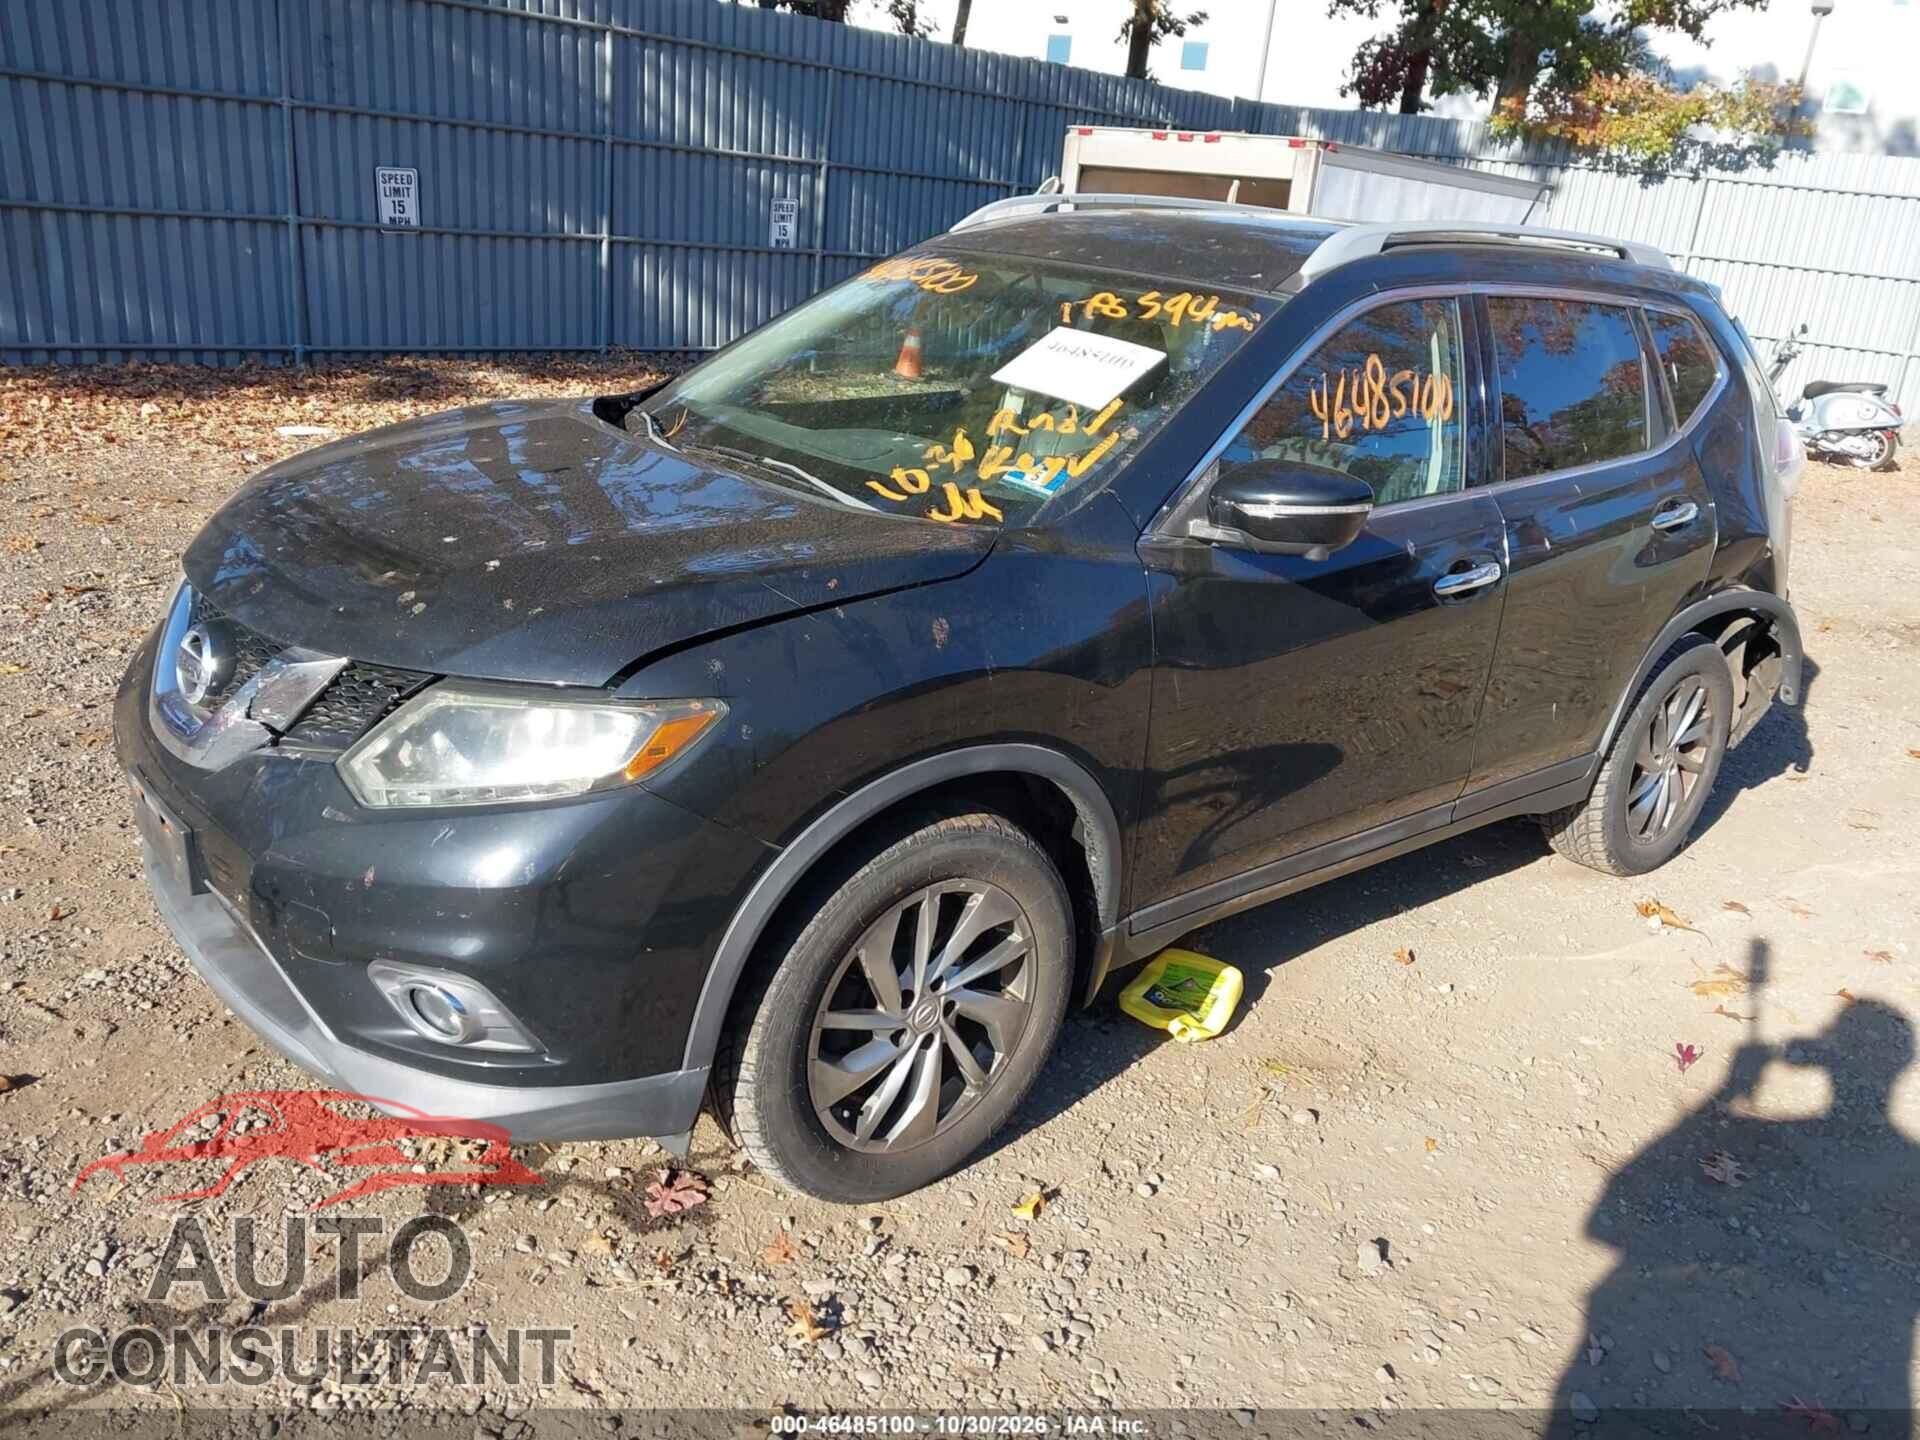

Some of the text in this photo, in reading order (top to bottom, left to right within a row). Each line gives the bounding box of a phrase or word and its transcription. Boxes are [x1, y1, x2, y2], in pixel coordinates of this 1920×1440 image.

[381, 173, 412, 184] SPEED
[384, 186, 411, 198] LIMIT
[392, 200, 405, 214] 15
[774, 203, 794, 212] SPEED
[389, 216, 411, 224] MPH
[774, 214, 792, 222] LIMIT
[779, 225, 788, 236] 15
[1309, 353, 1453, 443] 46485100
